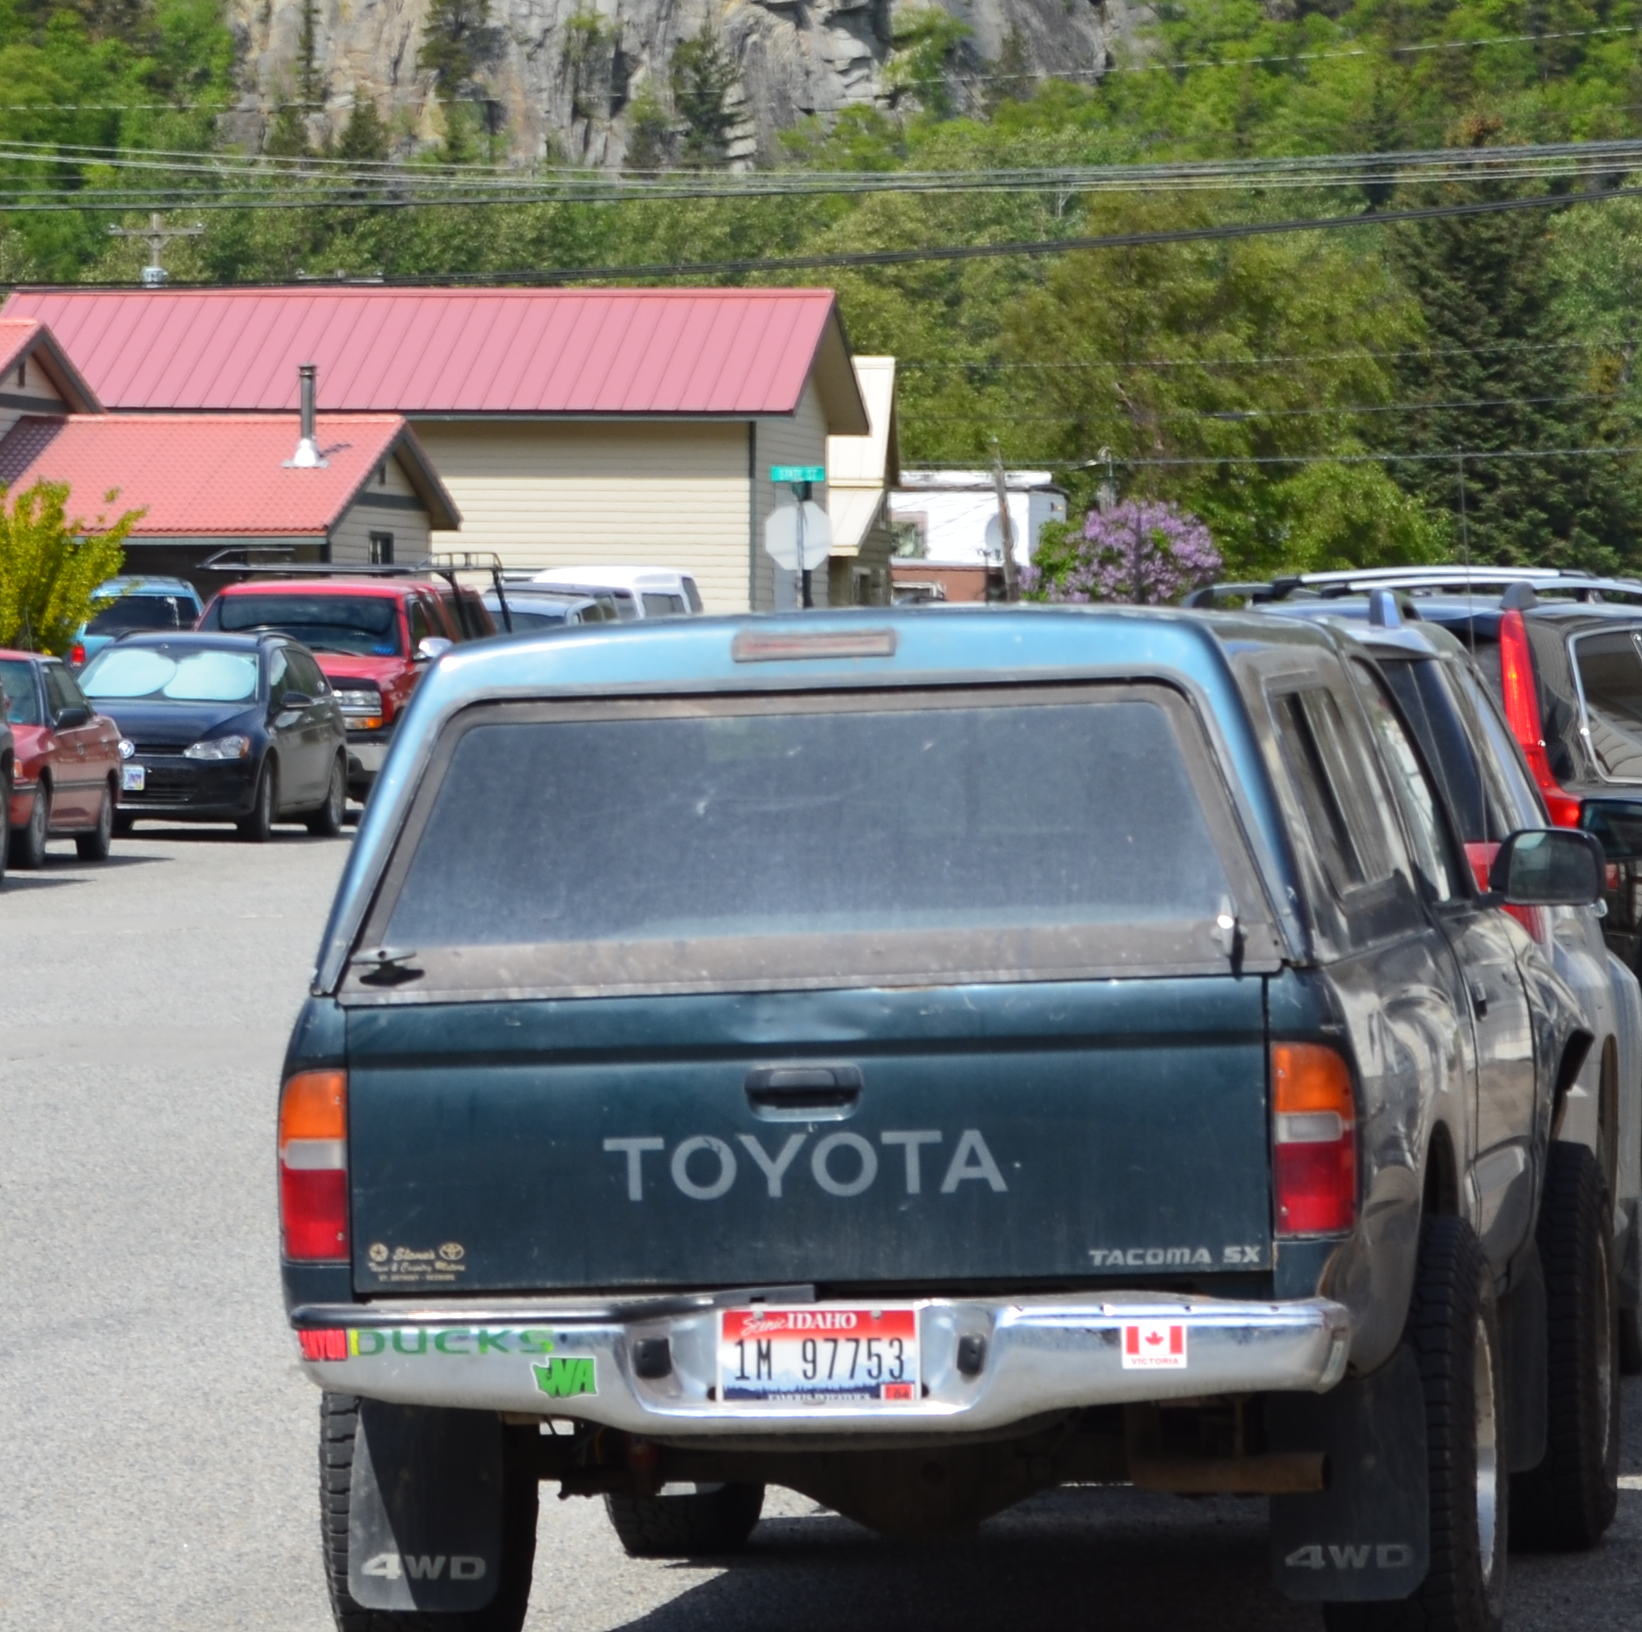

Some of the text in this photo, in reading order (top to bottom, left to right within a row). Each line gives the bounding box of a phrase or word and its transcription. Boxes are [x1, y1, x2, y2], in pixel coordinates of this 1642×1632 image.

[603, 1129, 1009, 1202] TOYOTA
[1088, 1245, 1261, 1266] TACOMA SX
[741, 1312, 857, 1336] Scenic IDAHO
[351, 1329, 553, 1356] DUCKS
[735, 1338, 905, 1381] 1M 97753
[1131, 1357, 1179, 1365] VICTORIA
[532, 1358, 597, 1398] WA
[361, 1553, 486, 1580] 4WD
[1285, 1544, 1414, 1570] 4WD
